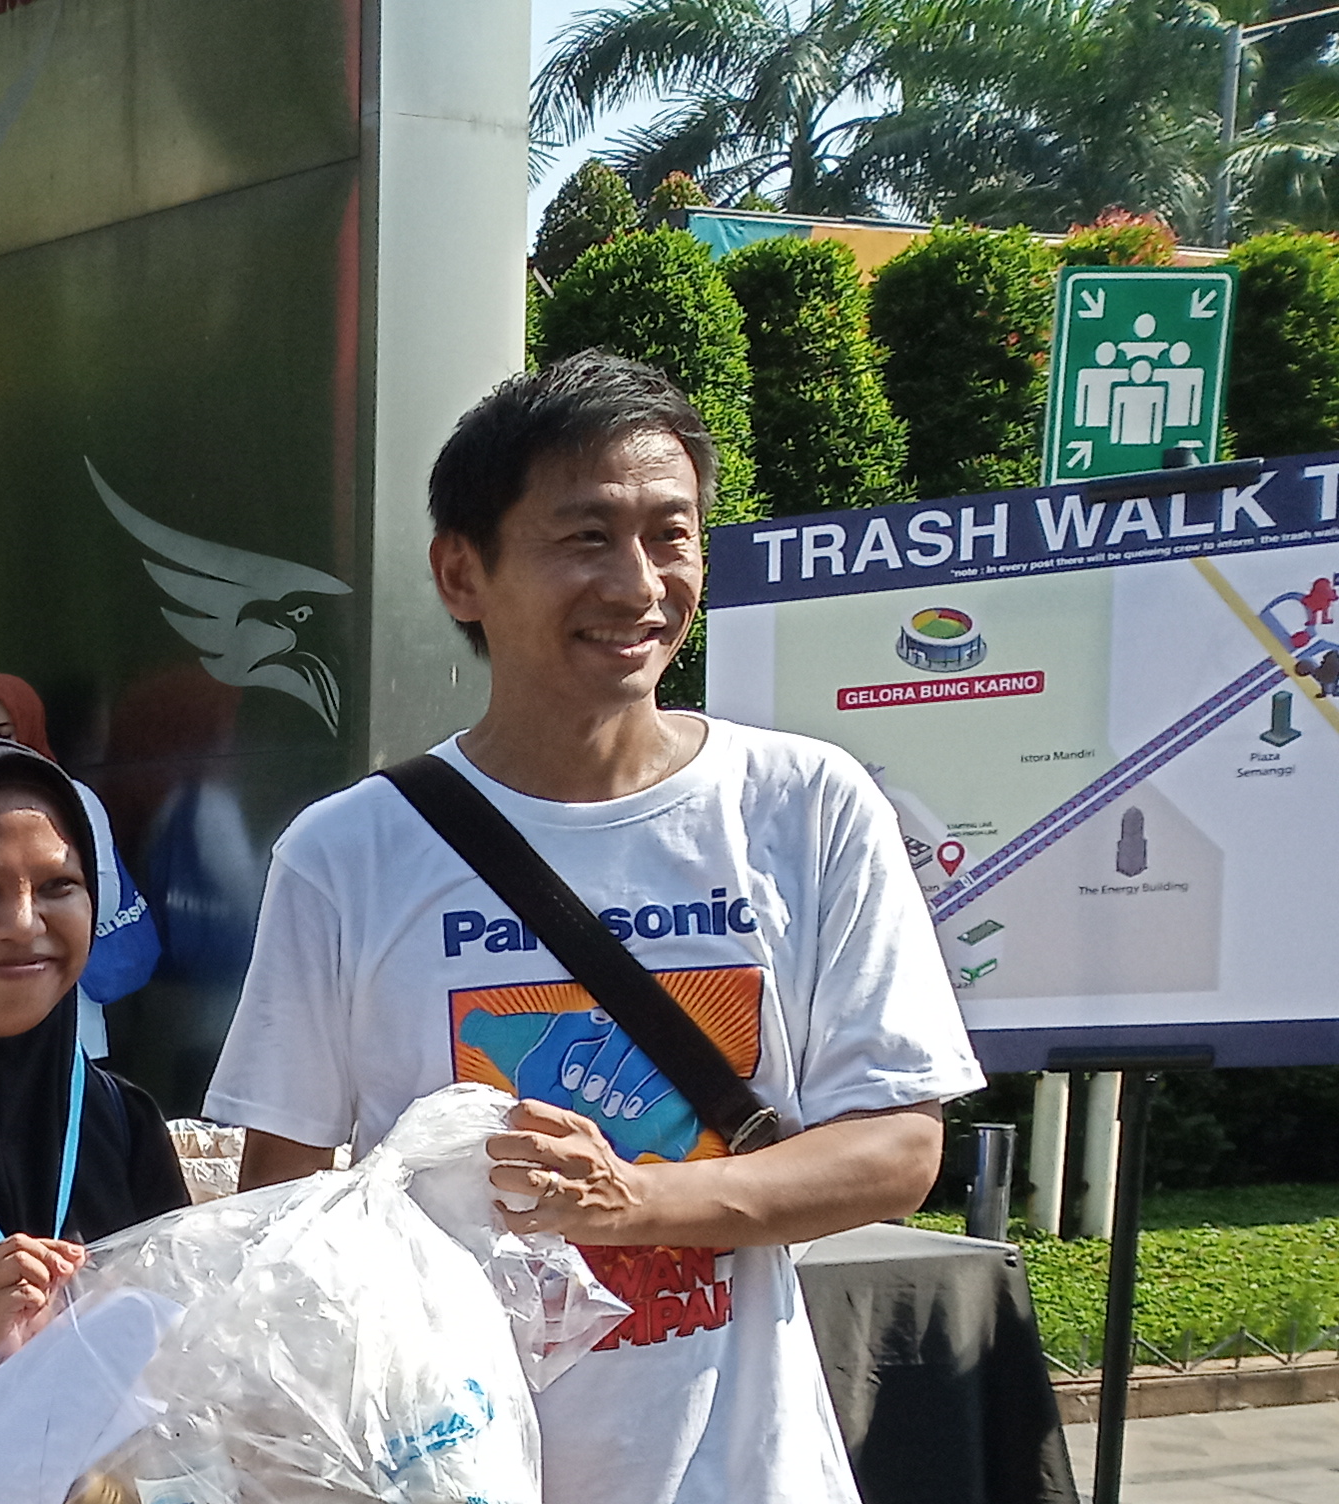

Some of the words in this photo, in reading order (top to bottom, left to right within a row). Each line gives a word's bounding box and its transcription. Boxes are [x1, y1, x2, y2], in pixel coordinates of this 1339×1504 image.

[752, 500, 1010, 583] TRASH
[1034, 470, 1278, 552] WALK
[998, 562, 1029, 573] every
[1029, 559, 1055, 571] post
[1056, 556, 1085, 567] there
[1107, 552, 1123, 561] be
[1260, 534, 1280, 545] the
[845, 687, 916, 706] GELORA
[920, 681, 969, 698] BUNG
[974, 675, 1038, 694] KARNO
[1053, 748, 1096, 761] Mandiri
[1250, 751, 1281, 763] Plaza
[1235, 764, 1296, 779] Semanggi
[1078, 884, 1099, 896] The
[1101, 884, 1140, 897] Energy
[1142, 880, 1190, 893] Building
[442, 887, 760, 958] Pasonic
